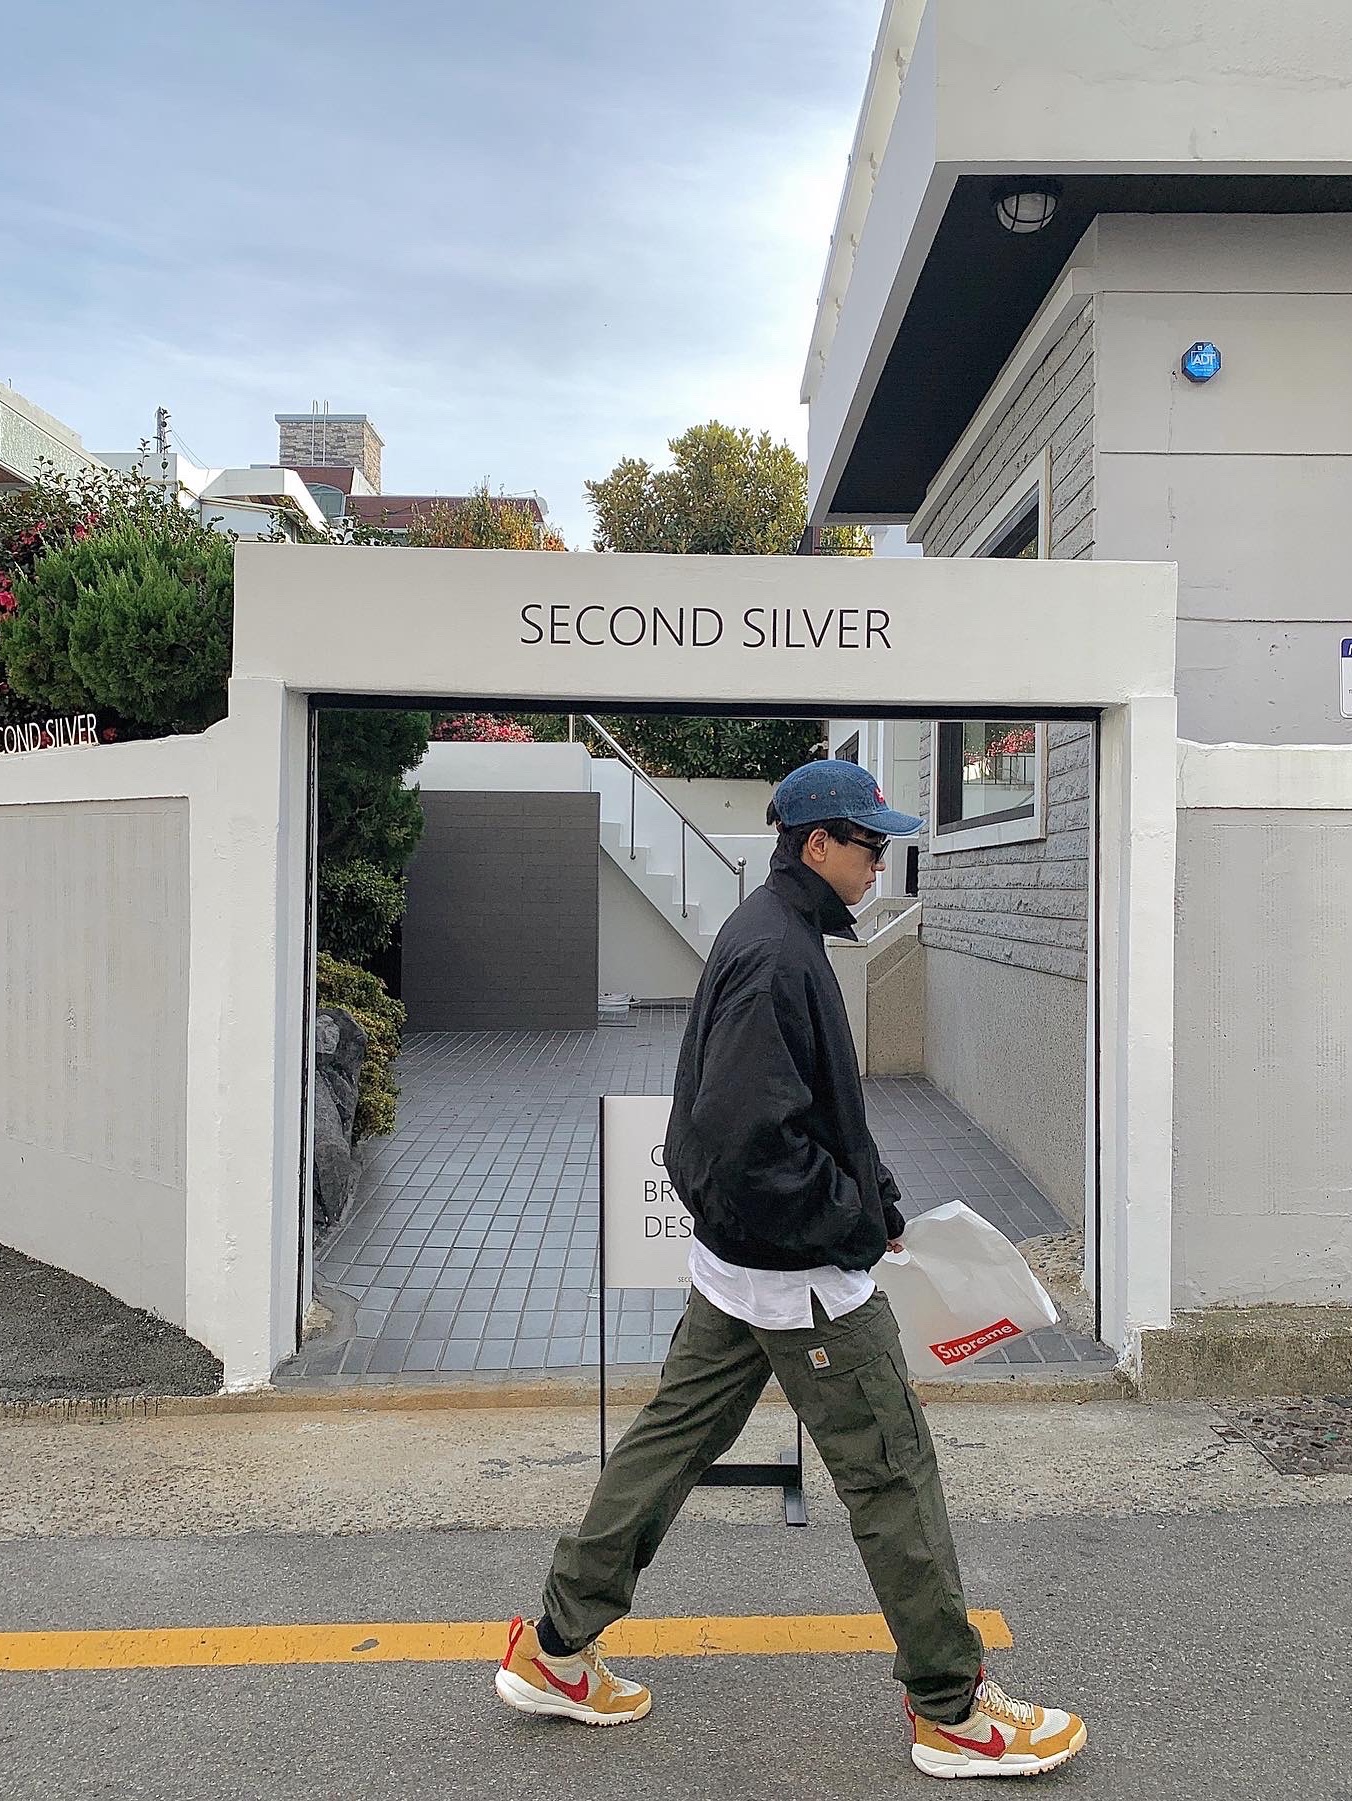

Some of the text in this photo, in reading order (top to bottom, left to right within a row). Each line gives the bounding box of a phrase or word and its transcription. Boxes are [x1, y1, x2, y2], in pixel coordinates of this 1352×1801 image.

[1191, 353, 1215, 366] ADT
[520, 603, 892, 649] SECOND SILVER
[45, 713, 100, 750] SILVER
[644, 1180, 675, 1202] BR
[644, 1215, 692, 1238] DES
[937, 1325, 1014, 1359] Supreme
